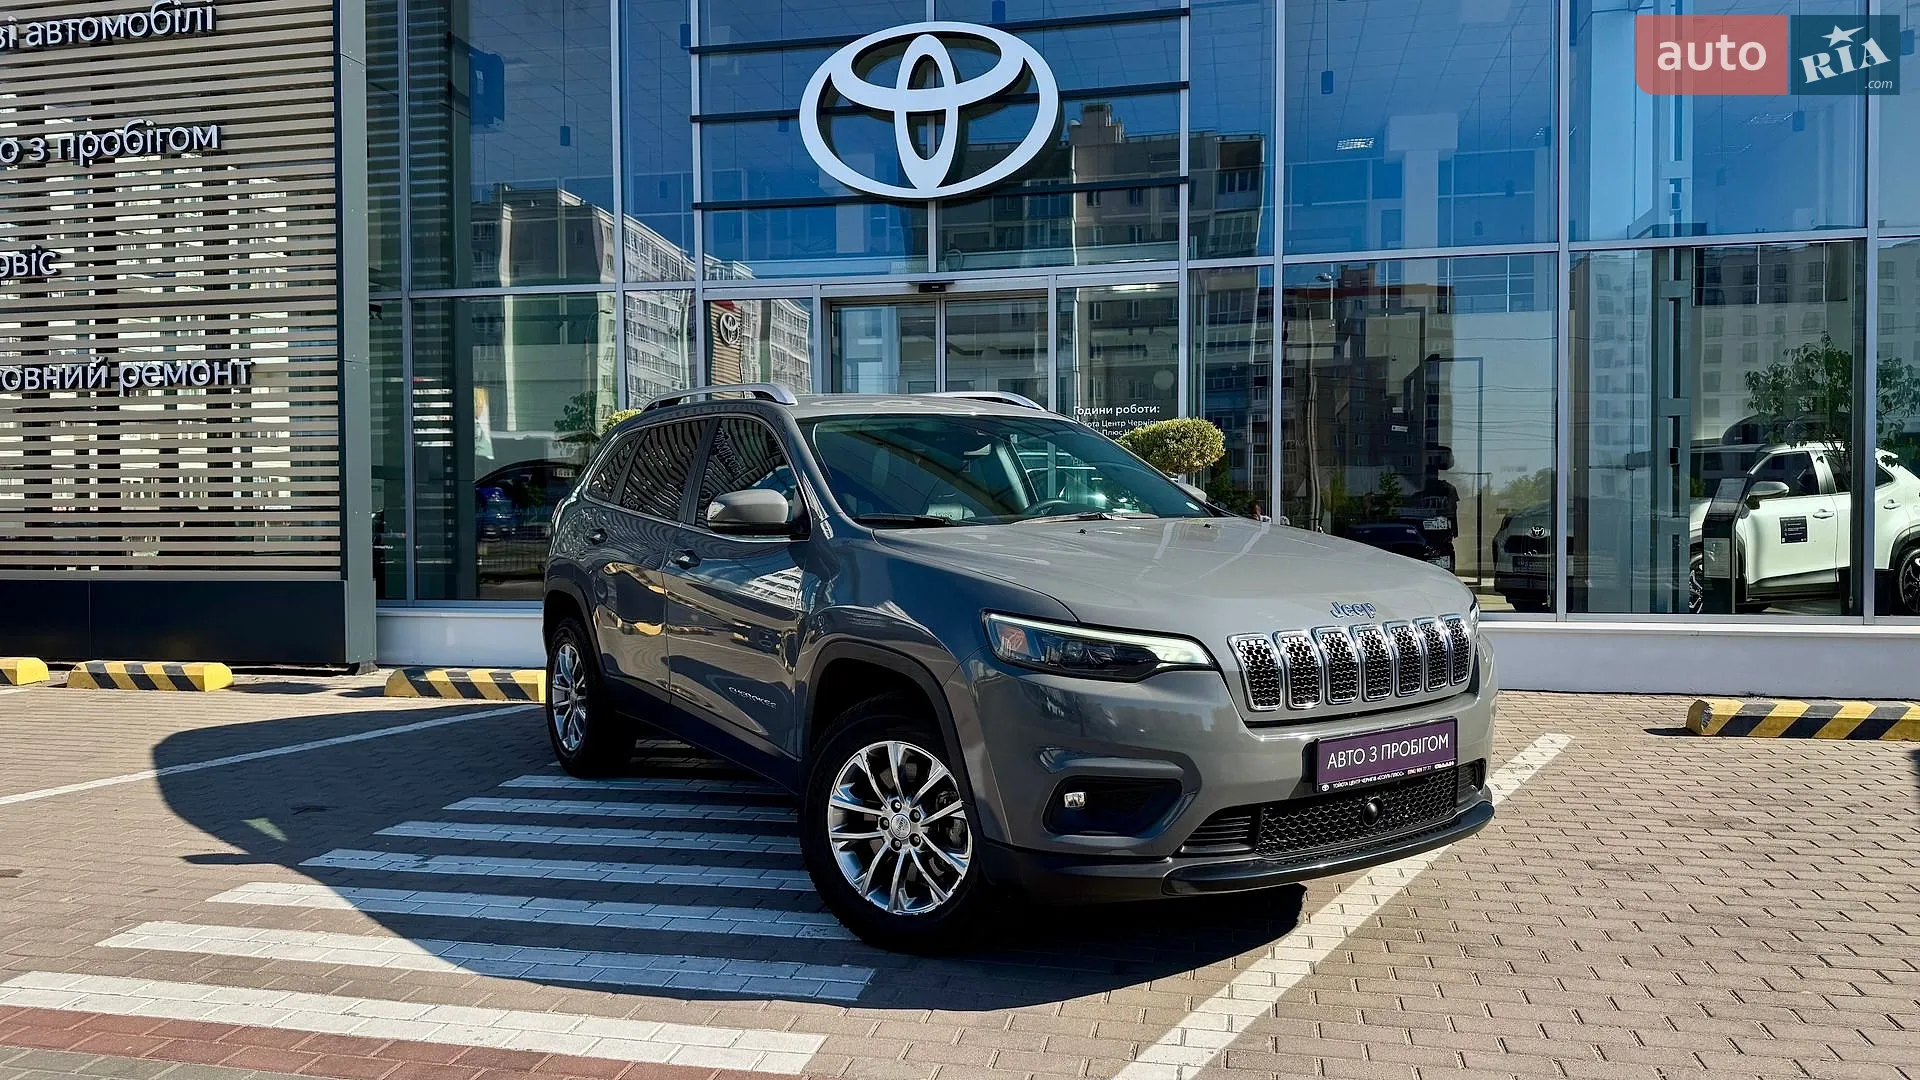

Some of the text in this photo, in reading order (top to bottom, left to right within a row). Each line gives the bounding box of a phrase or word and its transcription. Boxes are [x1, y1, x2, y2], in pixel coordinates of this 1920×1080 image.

[25, 0, 215, 47] автомобілі
[29, 137, 46, 161] з
[58, 119, 219, 167] пробігом
[0, 356, 252, 397] овний ремонт
[1073, 404, 1160, 416] Години роботи:
[1101, 419, 1126, 428] Центр
[1329, 601, 1377, 619] Jeep
[728, 686, 777, 710] CHEROKEE
[1327, 732, 1449, 770] АВТО З ПРОБІГОМ
